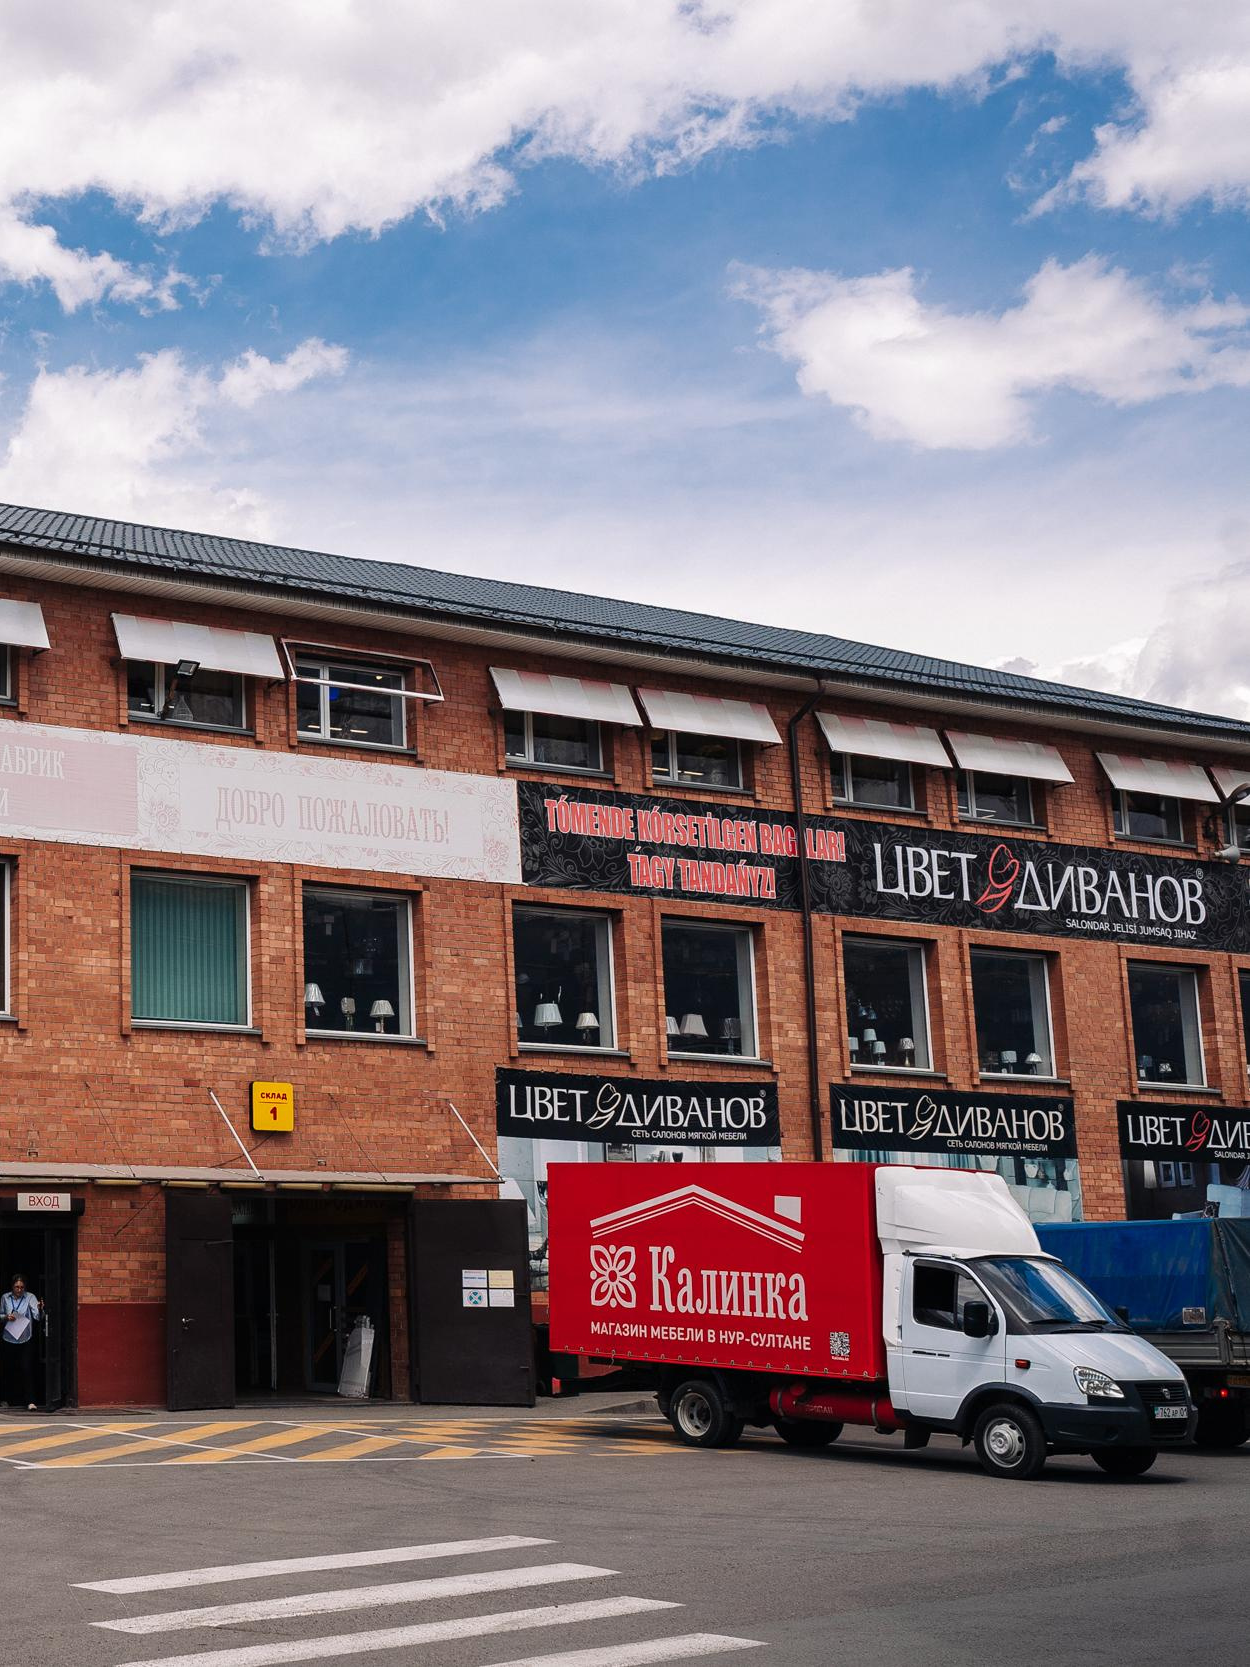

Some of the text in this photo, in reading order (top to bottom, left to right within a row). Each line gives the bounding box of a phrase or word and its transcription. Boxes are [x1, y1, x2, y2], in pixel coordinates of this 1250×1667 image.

[215, 786, 449, 844] ДОБРО ПОЖАЛОВАТЬ!
[873, 843, 1207, 925] ЦВЕТ ДИВАНОВ
[1066, 918, 1110, 932] SALONDAR
[1139, 925, 1172, 940] JUMSAQ
[260, 1092, 287, 1101] СКЛАД
[509, 1084, 767, 1129] ЦВЕТ ДИВАНОВ
[269, 1106, 278, 1121] 1
[840, 1099, 1065, 1141] ЦВЕТ ДИВАНОВ
[631, 1129, 747, 1141] СЕТЬ САЛОНОВ МЯГКОЙ МЕБЕЛИ
[947, 1139, 1048, 1152] СЕТЬ САЛОНОВ МЯГКОЙ МЕБЕЛИ
[1127, 1115, 1186, 1147] ЦВЕТ
[28, 1195, 60, 1208] ВХОД
[648, 1246, 808, 1321] Калинка
[591, 1321, 811, 1350] МАГАЗИН МЕБЕЛИ В НУР-СУЛТАНЕ
